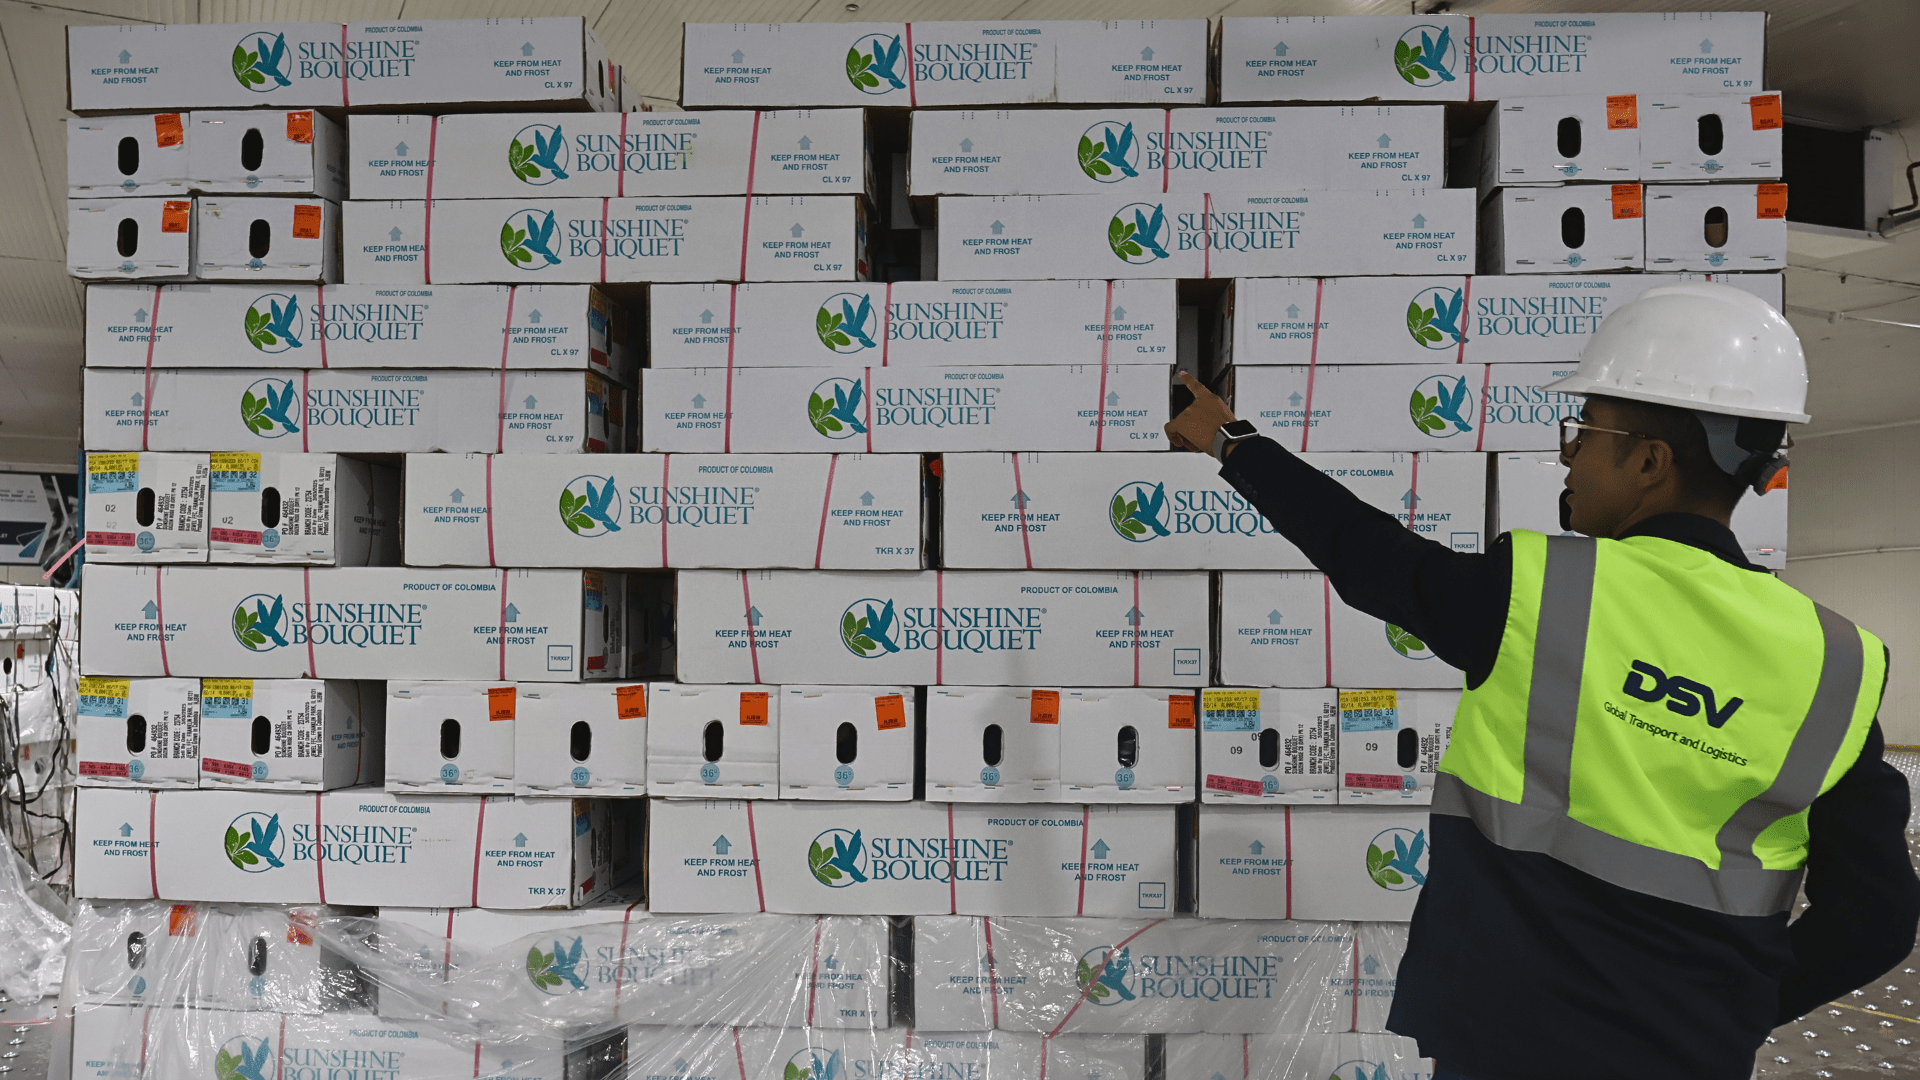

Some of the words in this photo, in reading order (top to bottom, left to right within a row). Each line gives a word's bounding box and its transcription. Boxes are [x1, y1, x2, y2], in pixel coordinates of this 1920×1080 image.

[300, 59, 415, 81] BOUQUET
[915, 61, 1032, 83] BOUQUET
[577, 152, 692, 174] BOUQUET
[1147, 150, 1267, 172] BOUQUET
[569, 238, 684, 259] BOUQUET
[1178, 230, 1300, 253] BOUQUET
[889, 321, 1003, 342] BOUQUET
[1478, 316, 1602, 337] BOUQUET
[309, 408, 419, 428] BOUQUET
[877, 406, 996, 428] BOUQUET
[105, 504, 116, 512] 02
[630, 506, 754, 527] BOUQUET
[293, 624, 422, 648] BOUQUET
[904, 628, 1041, 654] BOUQUET
[1622, 659, 1744, 729] DSV
[1385, 708, 1394, 716] 33
[1604, 701, 1627, 721] Global
[1629, 713, 1679, 742] Transport
[1679, 735, 1700, 750] and
[1700, 741, 1748, 767] Logistics
[1230, 746, 1243, 754] 09
[1365, 743, 1378, 751] 09
[359, 805, 388, 813] PRODUCT
[292, 843, 412, 865] BOUQUET
[872, 860, 1008, 883] BOUQUET
[528, 887, 545, 895] TKR
[1141, 978, 1276, 1001] BOUQUET
